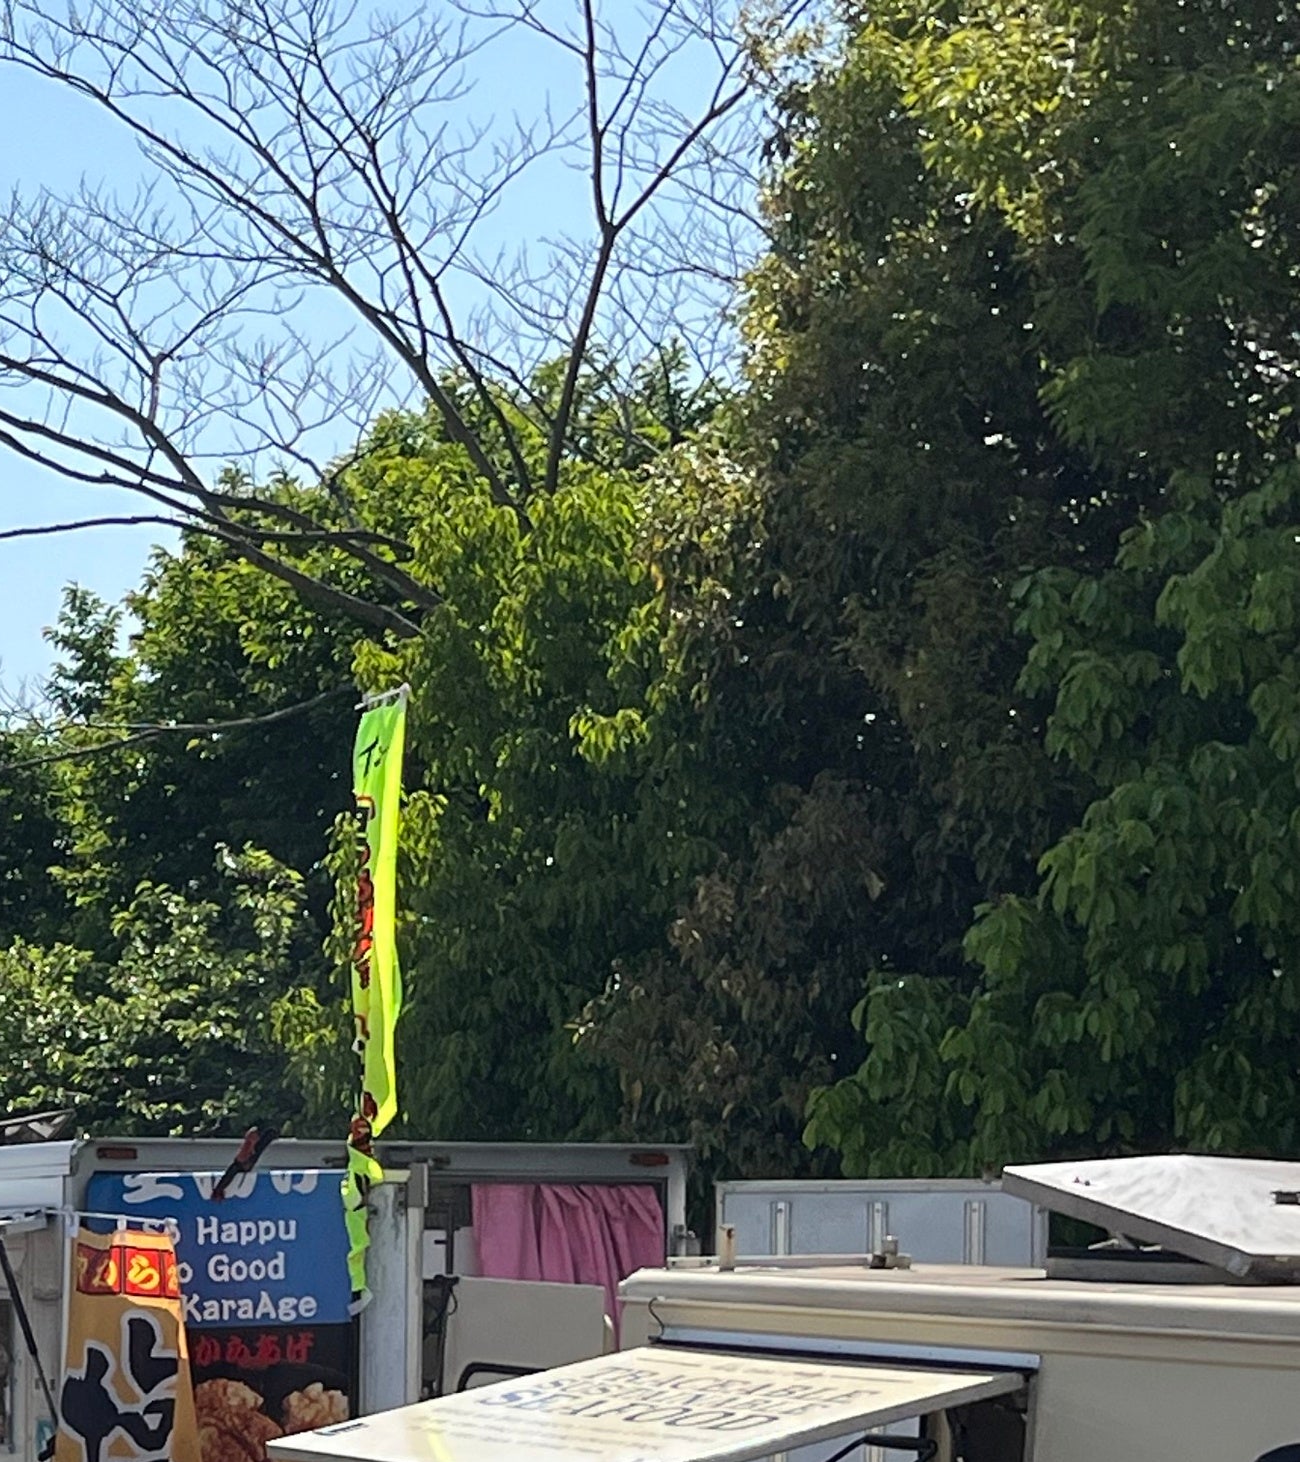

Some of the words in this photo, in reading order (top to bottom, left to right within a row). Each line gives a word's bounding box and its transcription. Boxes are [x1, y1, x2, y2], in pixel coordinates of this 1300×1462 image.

[196, 1215, 296, 1246] Happu
[207, 1250, 286, 1282] Good
[182, 1290, 318, 1323] KaraAge
[586, 1365, 879, 1403] TRACEABLE
[481, 1389, 779, 1431] SEAFOOD
